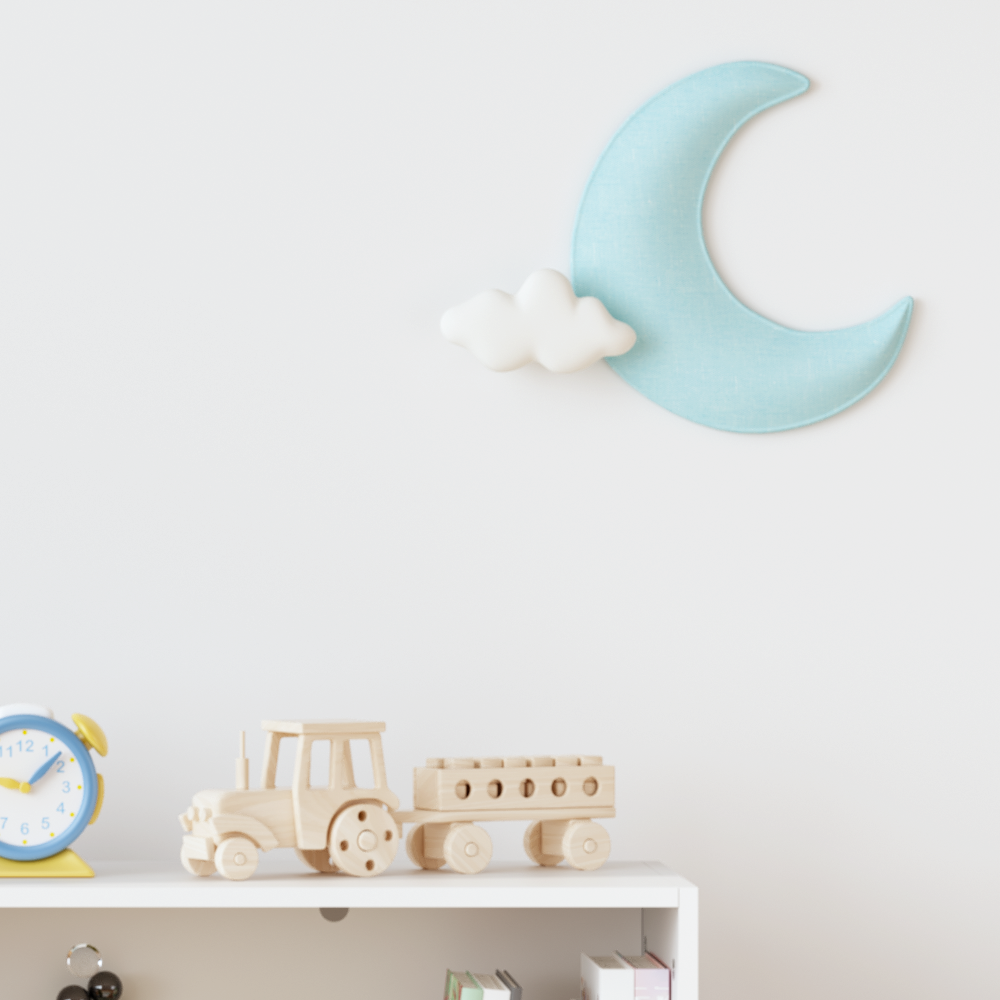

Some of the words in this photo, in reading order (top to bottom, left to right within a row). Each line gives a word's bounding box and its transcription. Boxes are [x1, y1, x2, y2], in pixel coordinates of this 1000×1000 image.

[16, 739, 34, 752] 12
[42, 744, 49, 757] 1
[56, 760, 65, 773] 2
[62, 781, 71, 794] 3
[56, 802, 65, 814] 4
[0, 817, 8, 829] 7
[20, 822, 30, 835] 6
[41, 817, 50, 830] 5
